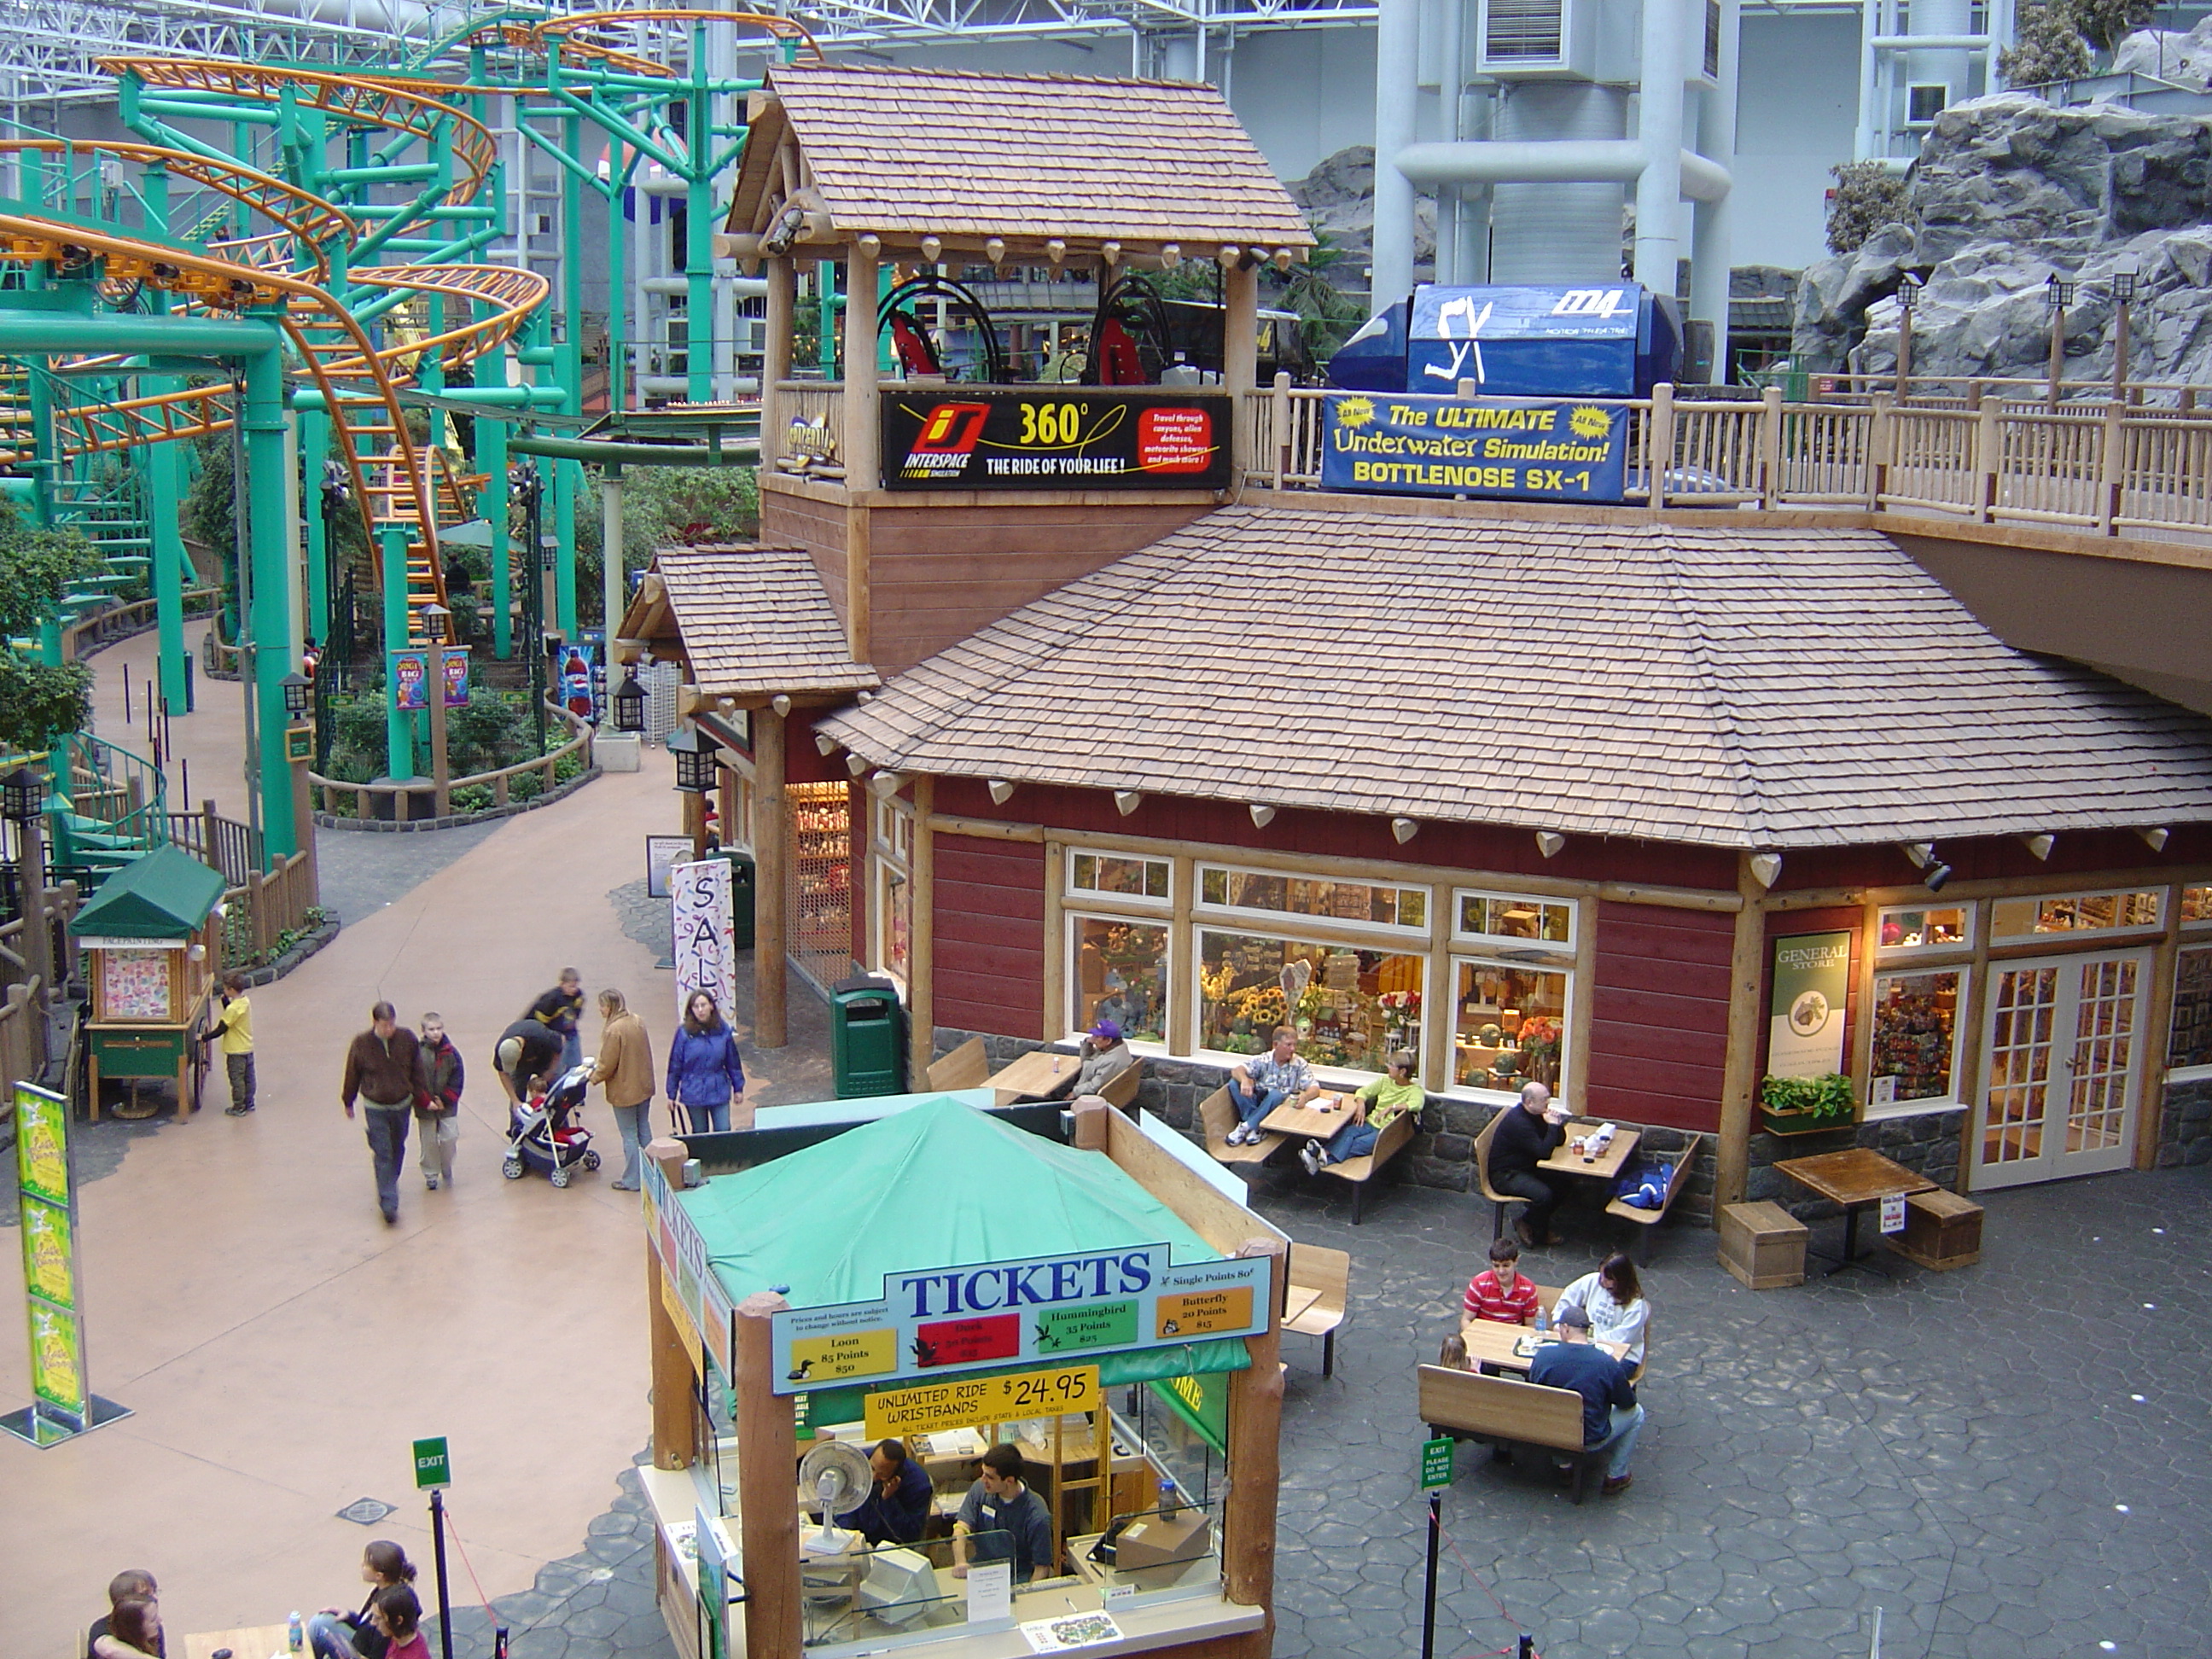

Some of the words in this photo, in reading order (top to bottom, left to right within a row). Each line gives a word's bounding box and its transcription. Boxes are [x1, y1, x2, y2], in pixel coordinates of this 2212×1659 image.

[1153, 413, 1175, 422] Travel
[1176, 413, 1203, 424] through
[1389, 405, 1427, 426] The
[1435, 407, 1557, 431] ULTIMATE
[1575, 416, 1587, 424] All
[1587, 417, 1605, 428] New
[1184, 423, 1202, 433] alien
[1144, 444, 1179, 453] meteorite
[1179, 444, 1208, 453] showers
[1333, 428, 1478, 457] Underwater
[1483, 438, 1610, 463] Simulation!
[905, 453, 971, 469] INTERSPACE
[1147, 454, 1161, 463] and
[986, 457, 1010, 474] THE
[1011, 457, 1039, 474] RIDE
[1041, 457, 1058, 474] OF
[1058, 457, 1092, 474] YOUR
[1354, 462, 1516, 489] BOTTLENOSE
[1526, 471, 1590, 492] SX-1
[1778, 946, 1848, 963] GENERAL
[1792, 959, 1835, 970] STORE
[1173, 1274, 1203, 1286] Single
[1205, 1272, 1236, 1282] Points
[902, 1252, 1152, 1318] TICKETS
[1183, 1293, 1229, 1306] Butterfly
[864, 1307, 888, 1316] subject
[1051, 1304, 1126, 1322] Hummingbird
[1196, 1307, 1227, 1317] Points
[956, 1322, 982, 1331] Duck
[1066, 1326, 1078, 1336] 35
[1080, 1321, 1111, 1331] Points
[1196, 1320, 1212, 1329] $15
[831, 1338, 859, 1348] Loon
[961, 1335, 992, 1345] Points
[1079, 1335, 1097, 1343] $25
[821, 1353, 835, 1364] 85
[836, 1350, 870, 1361] Points
[835, 1365, 855, 1374] $50
[877, 1388, 949, 1410] UNLIMITED
[956, 1383, 987, 1399] RIDE
[888, 1400, 978, 1424] WRISTBANDS
[901, 1424, 912, 1433] ALL
[916, 1422, 939, 1431] TICKET
[941, 1418, 963, 1427] PRICES
[966, 1415, 990, 1424] INCLUDE
[992, 1412, 1012, 1420] STATE
[1022, 1408, 1042, 1417] LOCAL
[1045, 1405, 1064, 1414] TAXES
[1429, 1446, 1447, 1455] EXIT
[418, 1454, 445, 1468] EXIT
[1426, 1456, 1448, 1466] PLEASE
[1436, 1464, 1449, 1472] NOT
[1427, 1471, 1447, 1481] ENTER
